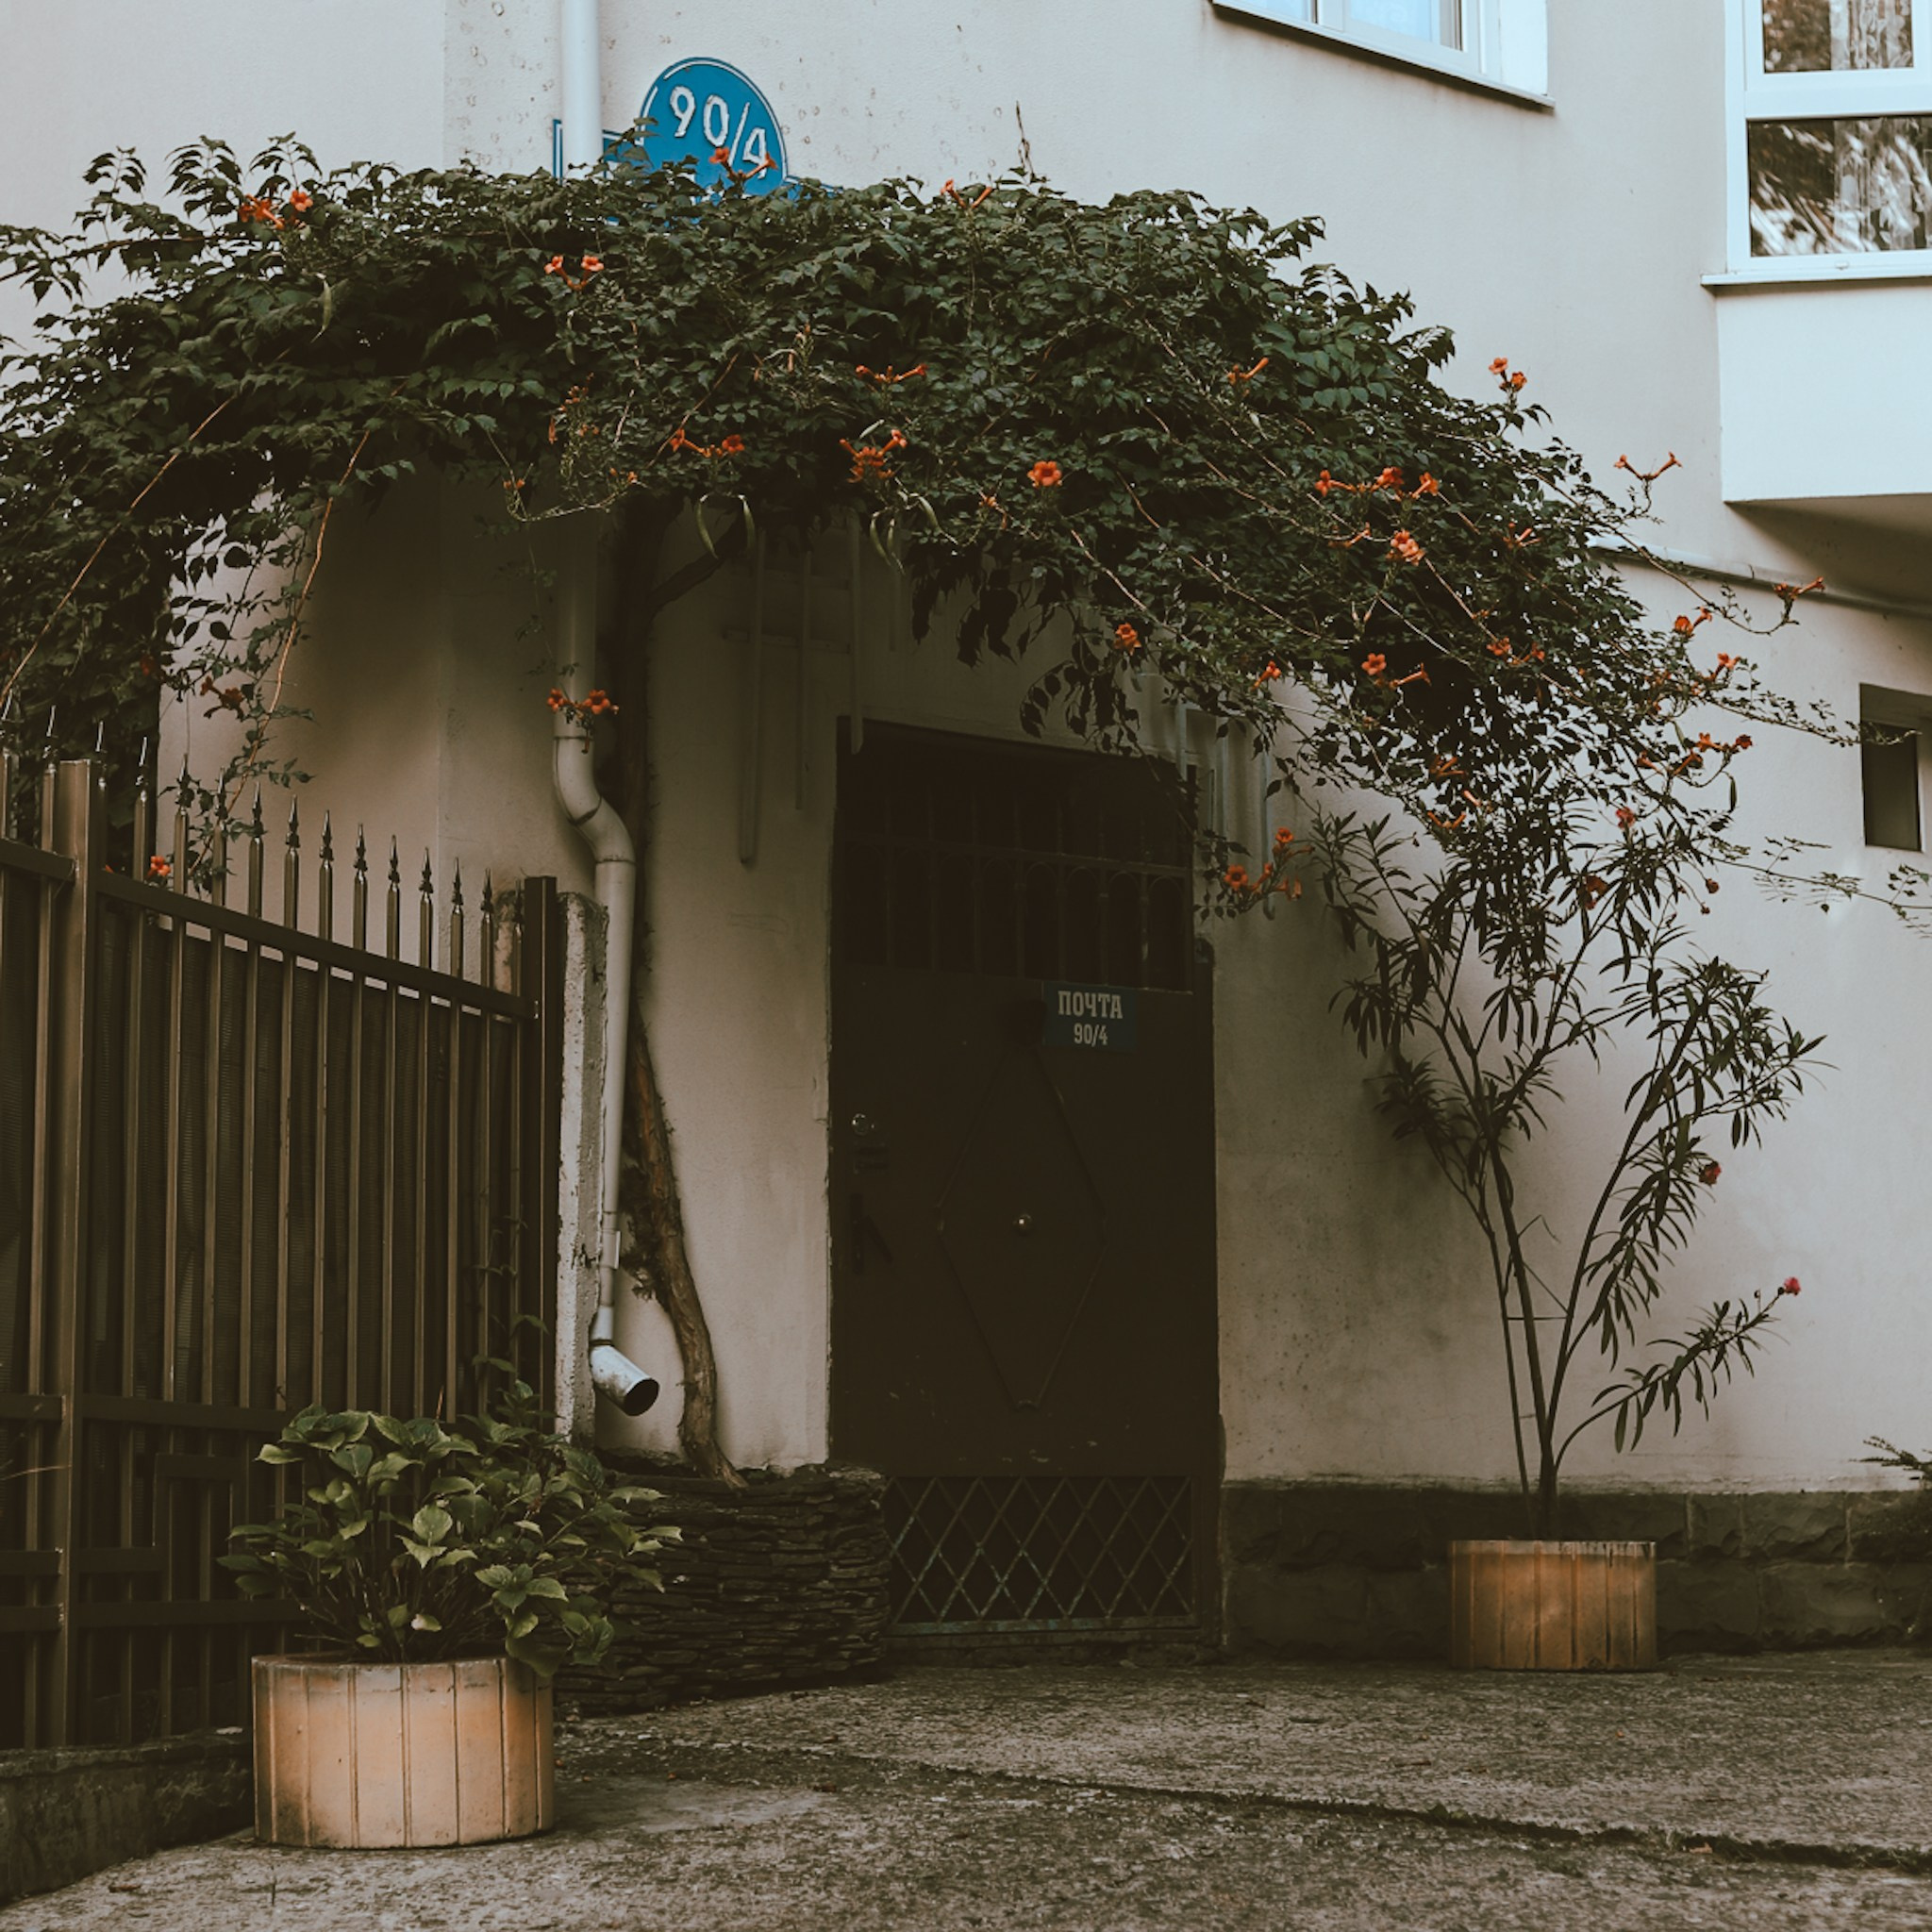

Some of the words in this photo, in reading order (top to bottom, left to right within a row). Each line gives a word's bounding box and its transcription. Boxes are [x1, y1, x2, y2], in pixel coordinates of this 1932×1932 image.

[670, 86, 766, 179] 90/4
[1058, 991, 1123, 1019] ПОЧТА
[1074, 1023, 1108, 1047] 90/4
